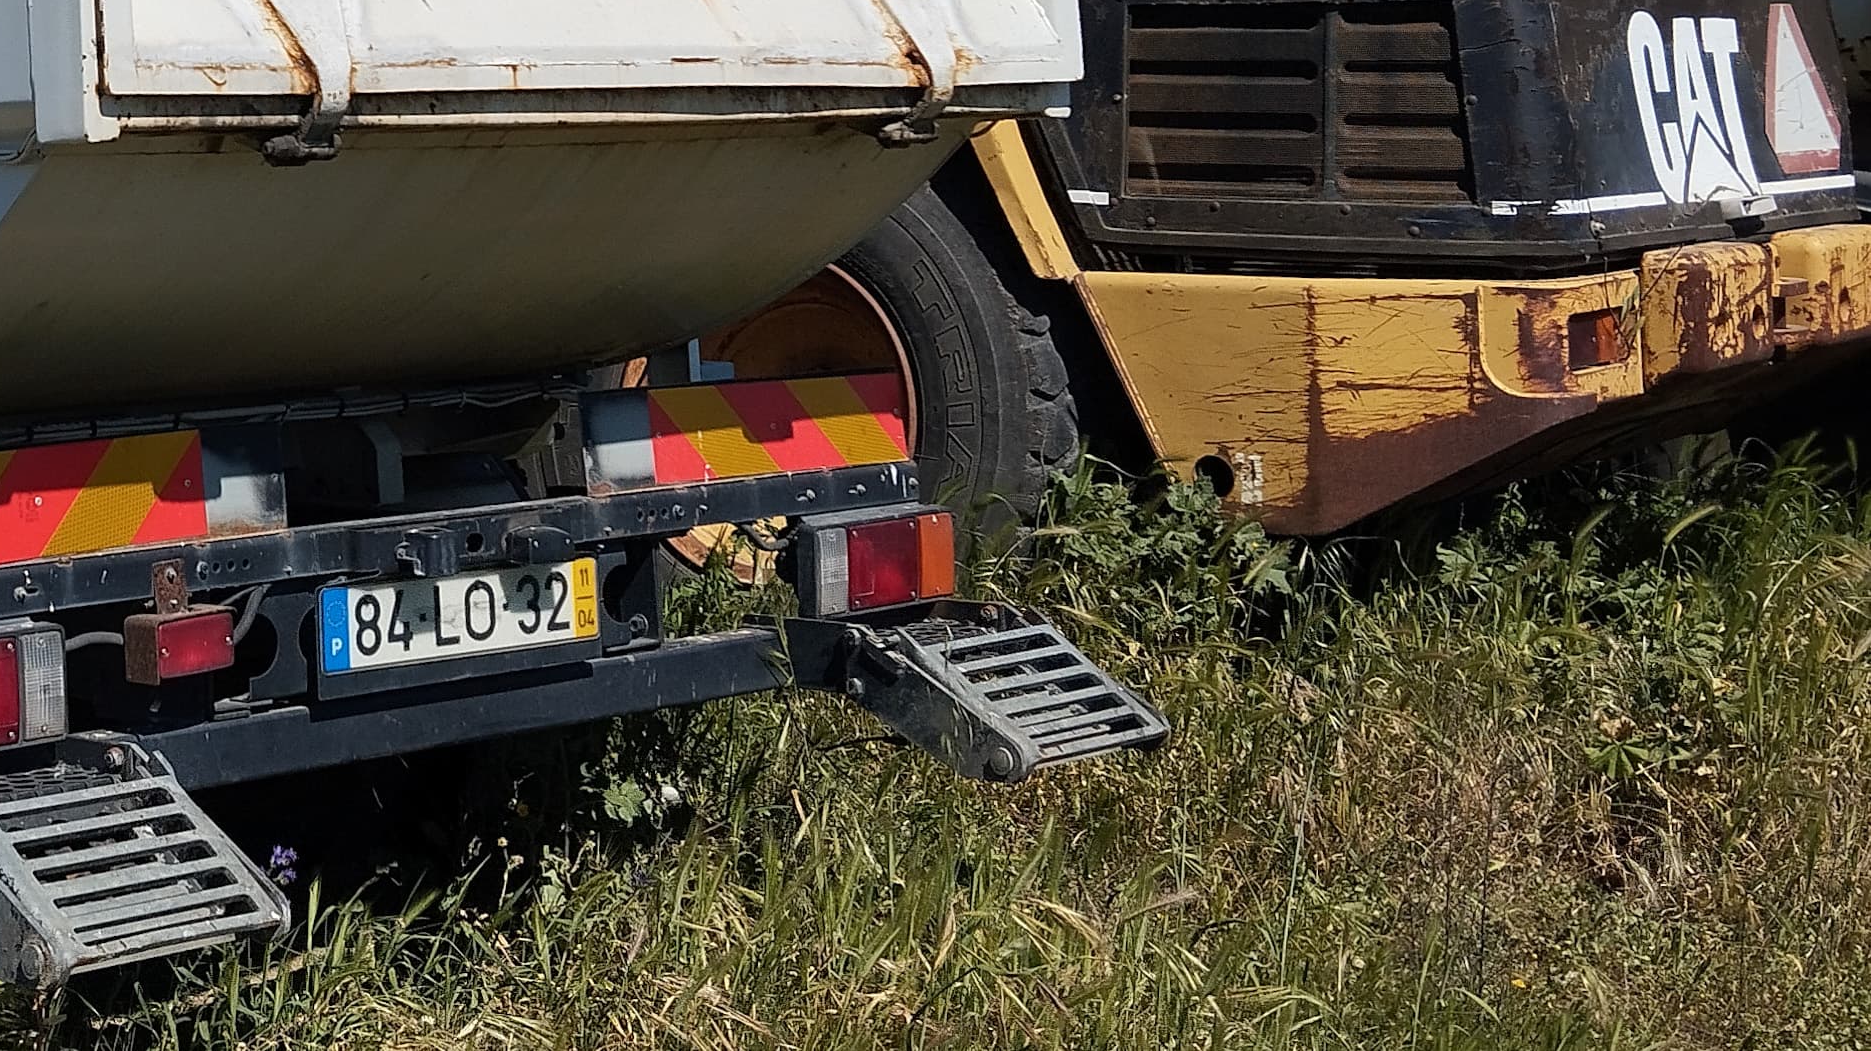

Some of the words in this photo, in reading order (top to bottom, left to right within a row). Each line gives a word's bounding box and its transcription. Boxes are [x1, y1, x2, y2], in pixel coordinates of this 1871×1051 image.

[1627, 11, 1764, 204] CAT
[578, 568, 590, 587] 11
[577, 609, 595, 629] 04
[331, 637, 343, 656] P
